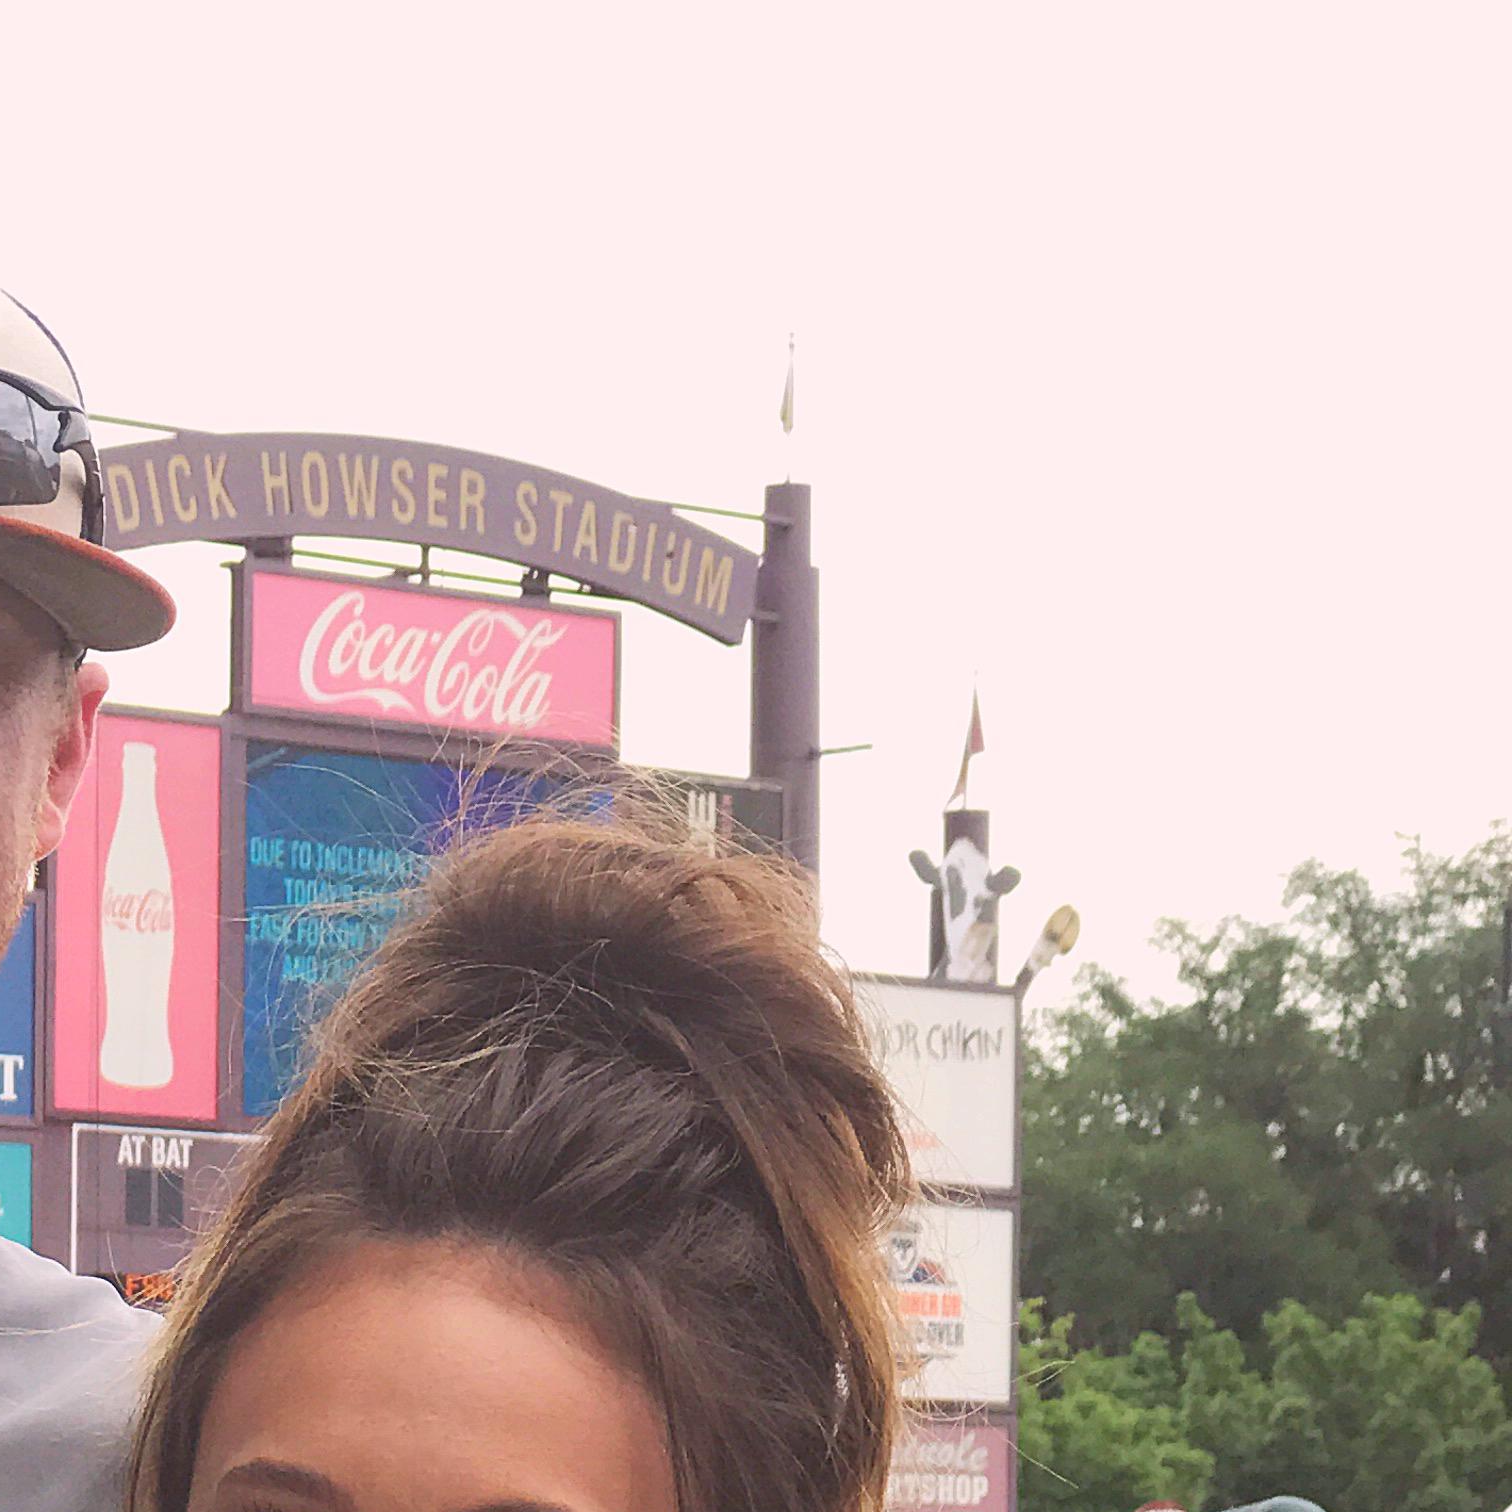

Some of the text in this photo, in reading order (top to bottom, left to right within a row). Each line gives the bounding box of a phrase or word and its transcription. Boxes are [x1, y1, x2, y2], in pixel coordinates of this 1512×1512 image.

[105, 449, 735, 617] DICK HOWSER STADIUM
[299, 589, 568, 728] Coca-Cola
[249, 835, 286, 868] DUE
[290, 839, 312, 870] TO
[925, 1018, 1004, 1062] CHIKIN
[117, 1133, 194, 1169] AT BAT
